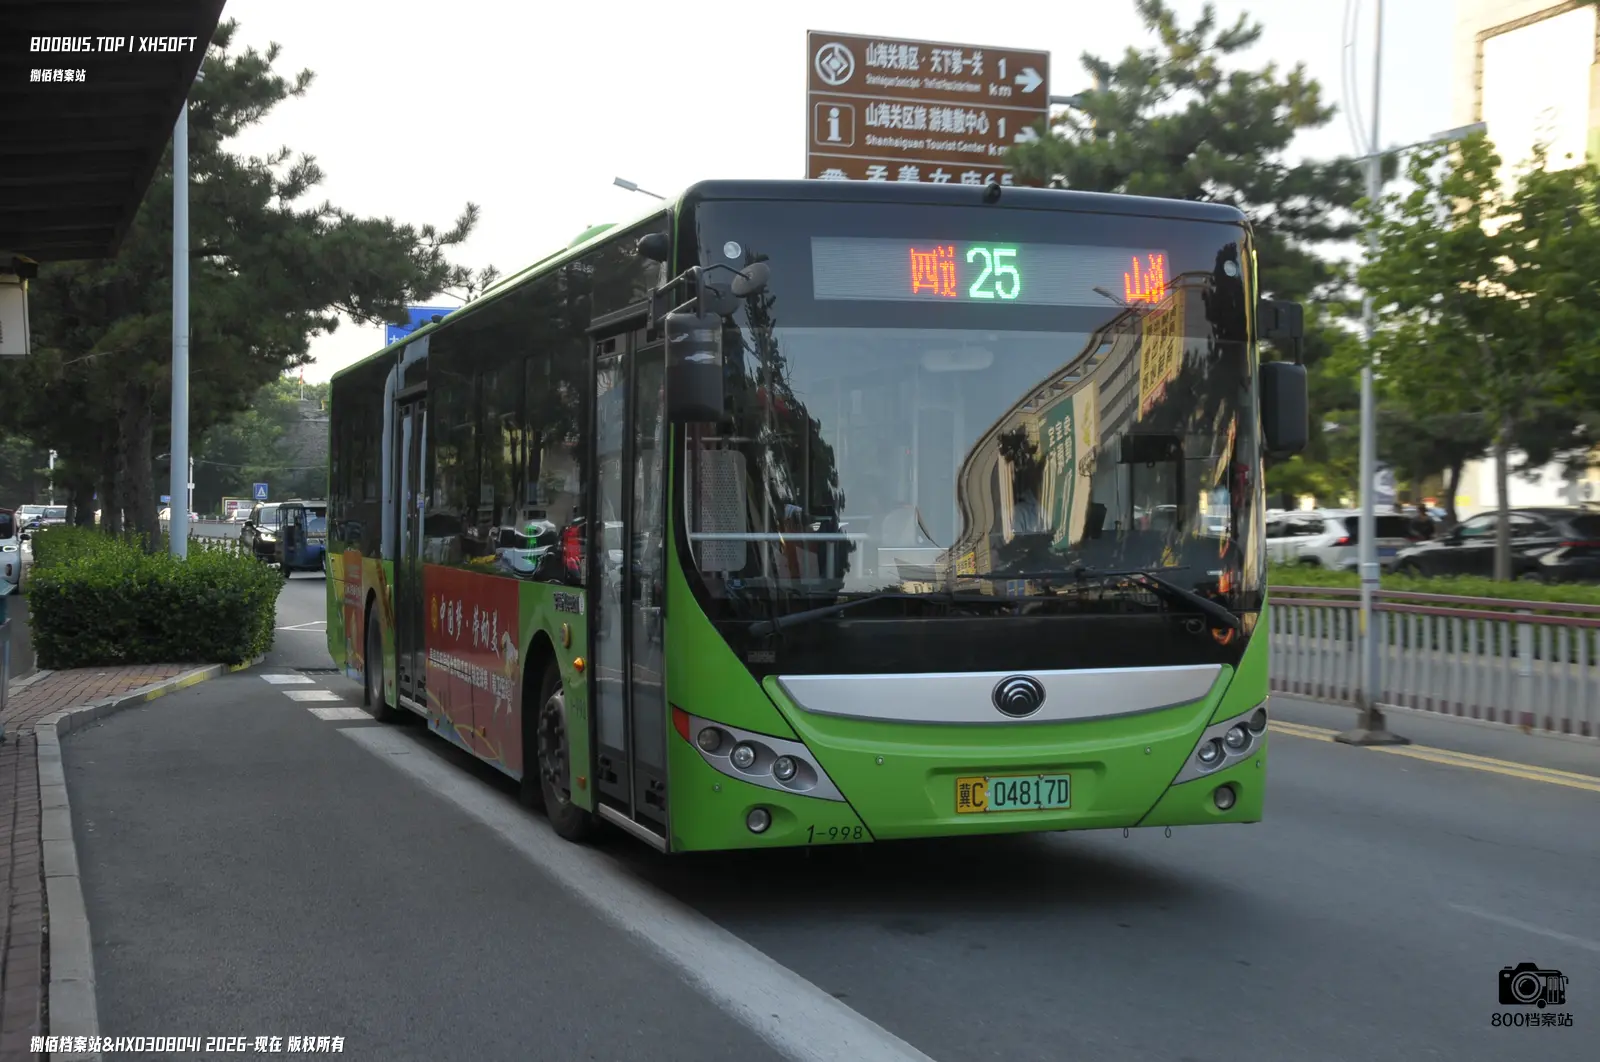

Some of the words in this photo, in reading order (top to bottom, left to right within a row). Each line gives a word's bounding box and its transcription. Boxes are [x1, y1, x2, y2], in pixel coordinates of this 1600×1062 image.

[998, 57, 1007, 80] 1
[997, 117, 1006, 138] 1
[865, 134, 925, 150] Shanhaiguan
[925, 138, 957, 151] Tourist
[957, 141, 986, 153] Center
[965, 247, 1021, 299] 25
[994, 779, 1069, 807] 04817D
[807, 824, 863, 843] 1-998
